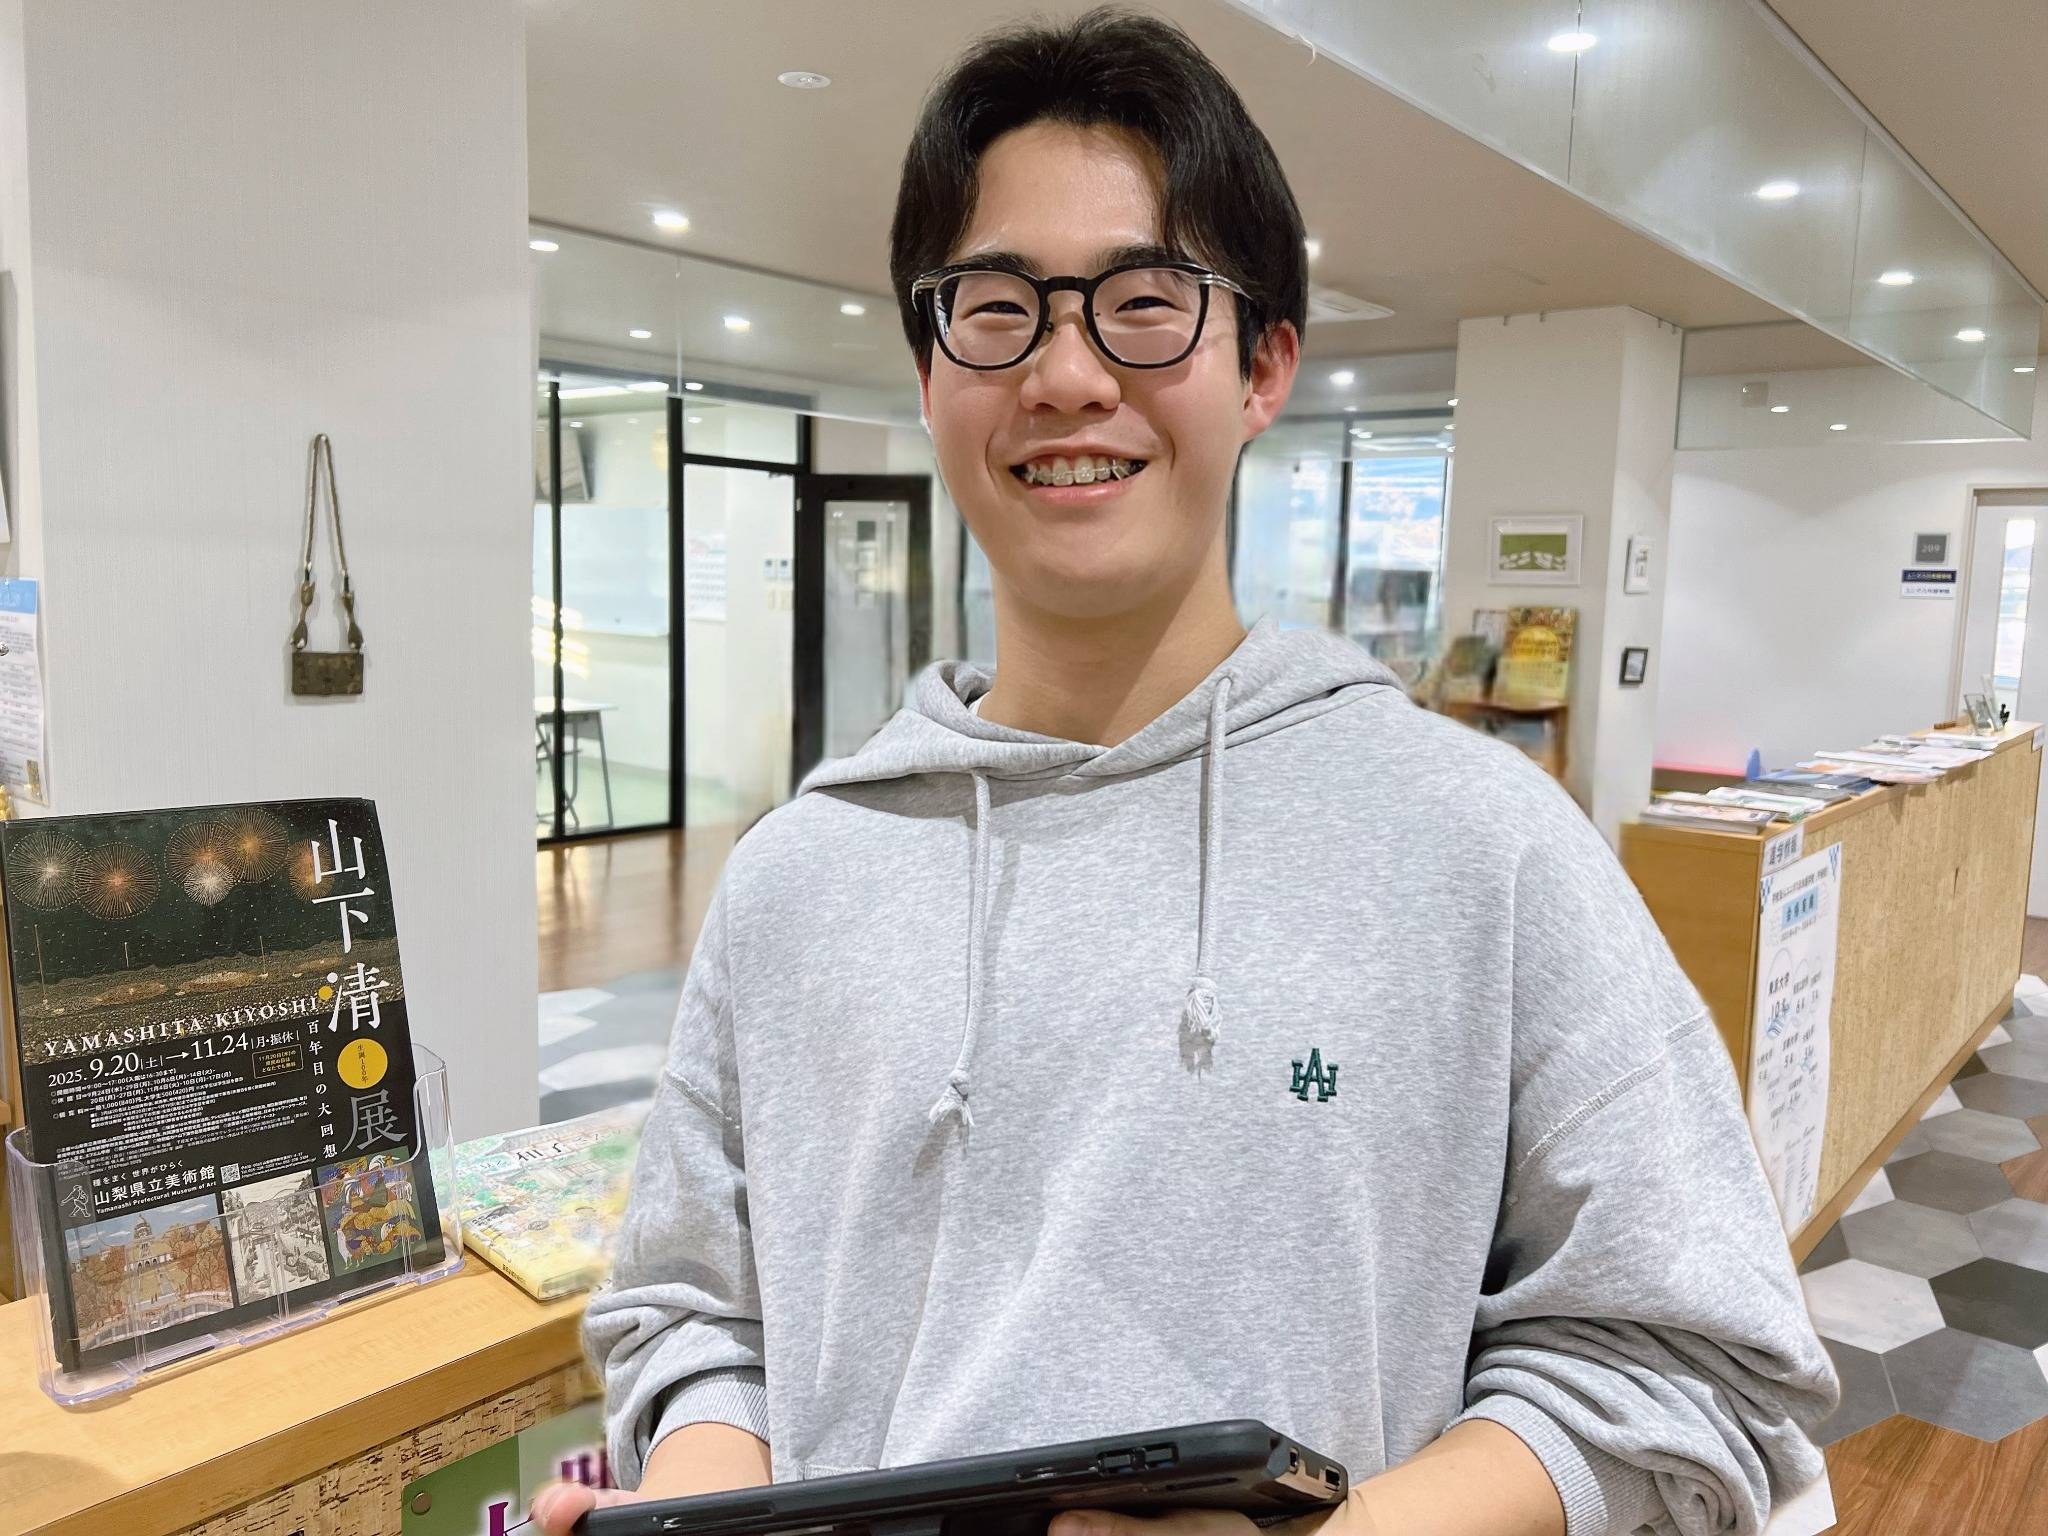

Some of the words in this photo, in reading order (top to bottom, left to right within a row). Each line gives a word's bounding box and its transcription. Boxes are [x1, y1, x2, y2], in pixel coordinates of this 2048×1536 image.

[44, 1017, 202, 1057] YAMASHITA
[216, 997, 318, 1028] KIYOSHI
[306, 1020, 338, 1158] 百年目の大回想
[94, 1165, 215, 1206] 山梨県立美術館
[132, 1159, 184, 1178] 世界がひらく
[96, 1202, 132, 1215] Yamanashi
[133, 1192, 170, 1206] Prefectural
[171, 1185, 197, 1196] Museum
[206, 1181, 216, 1189] Art
